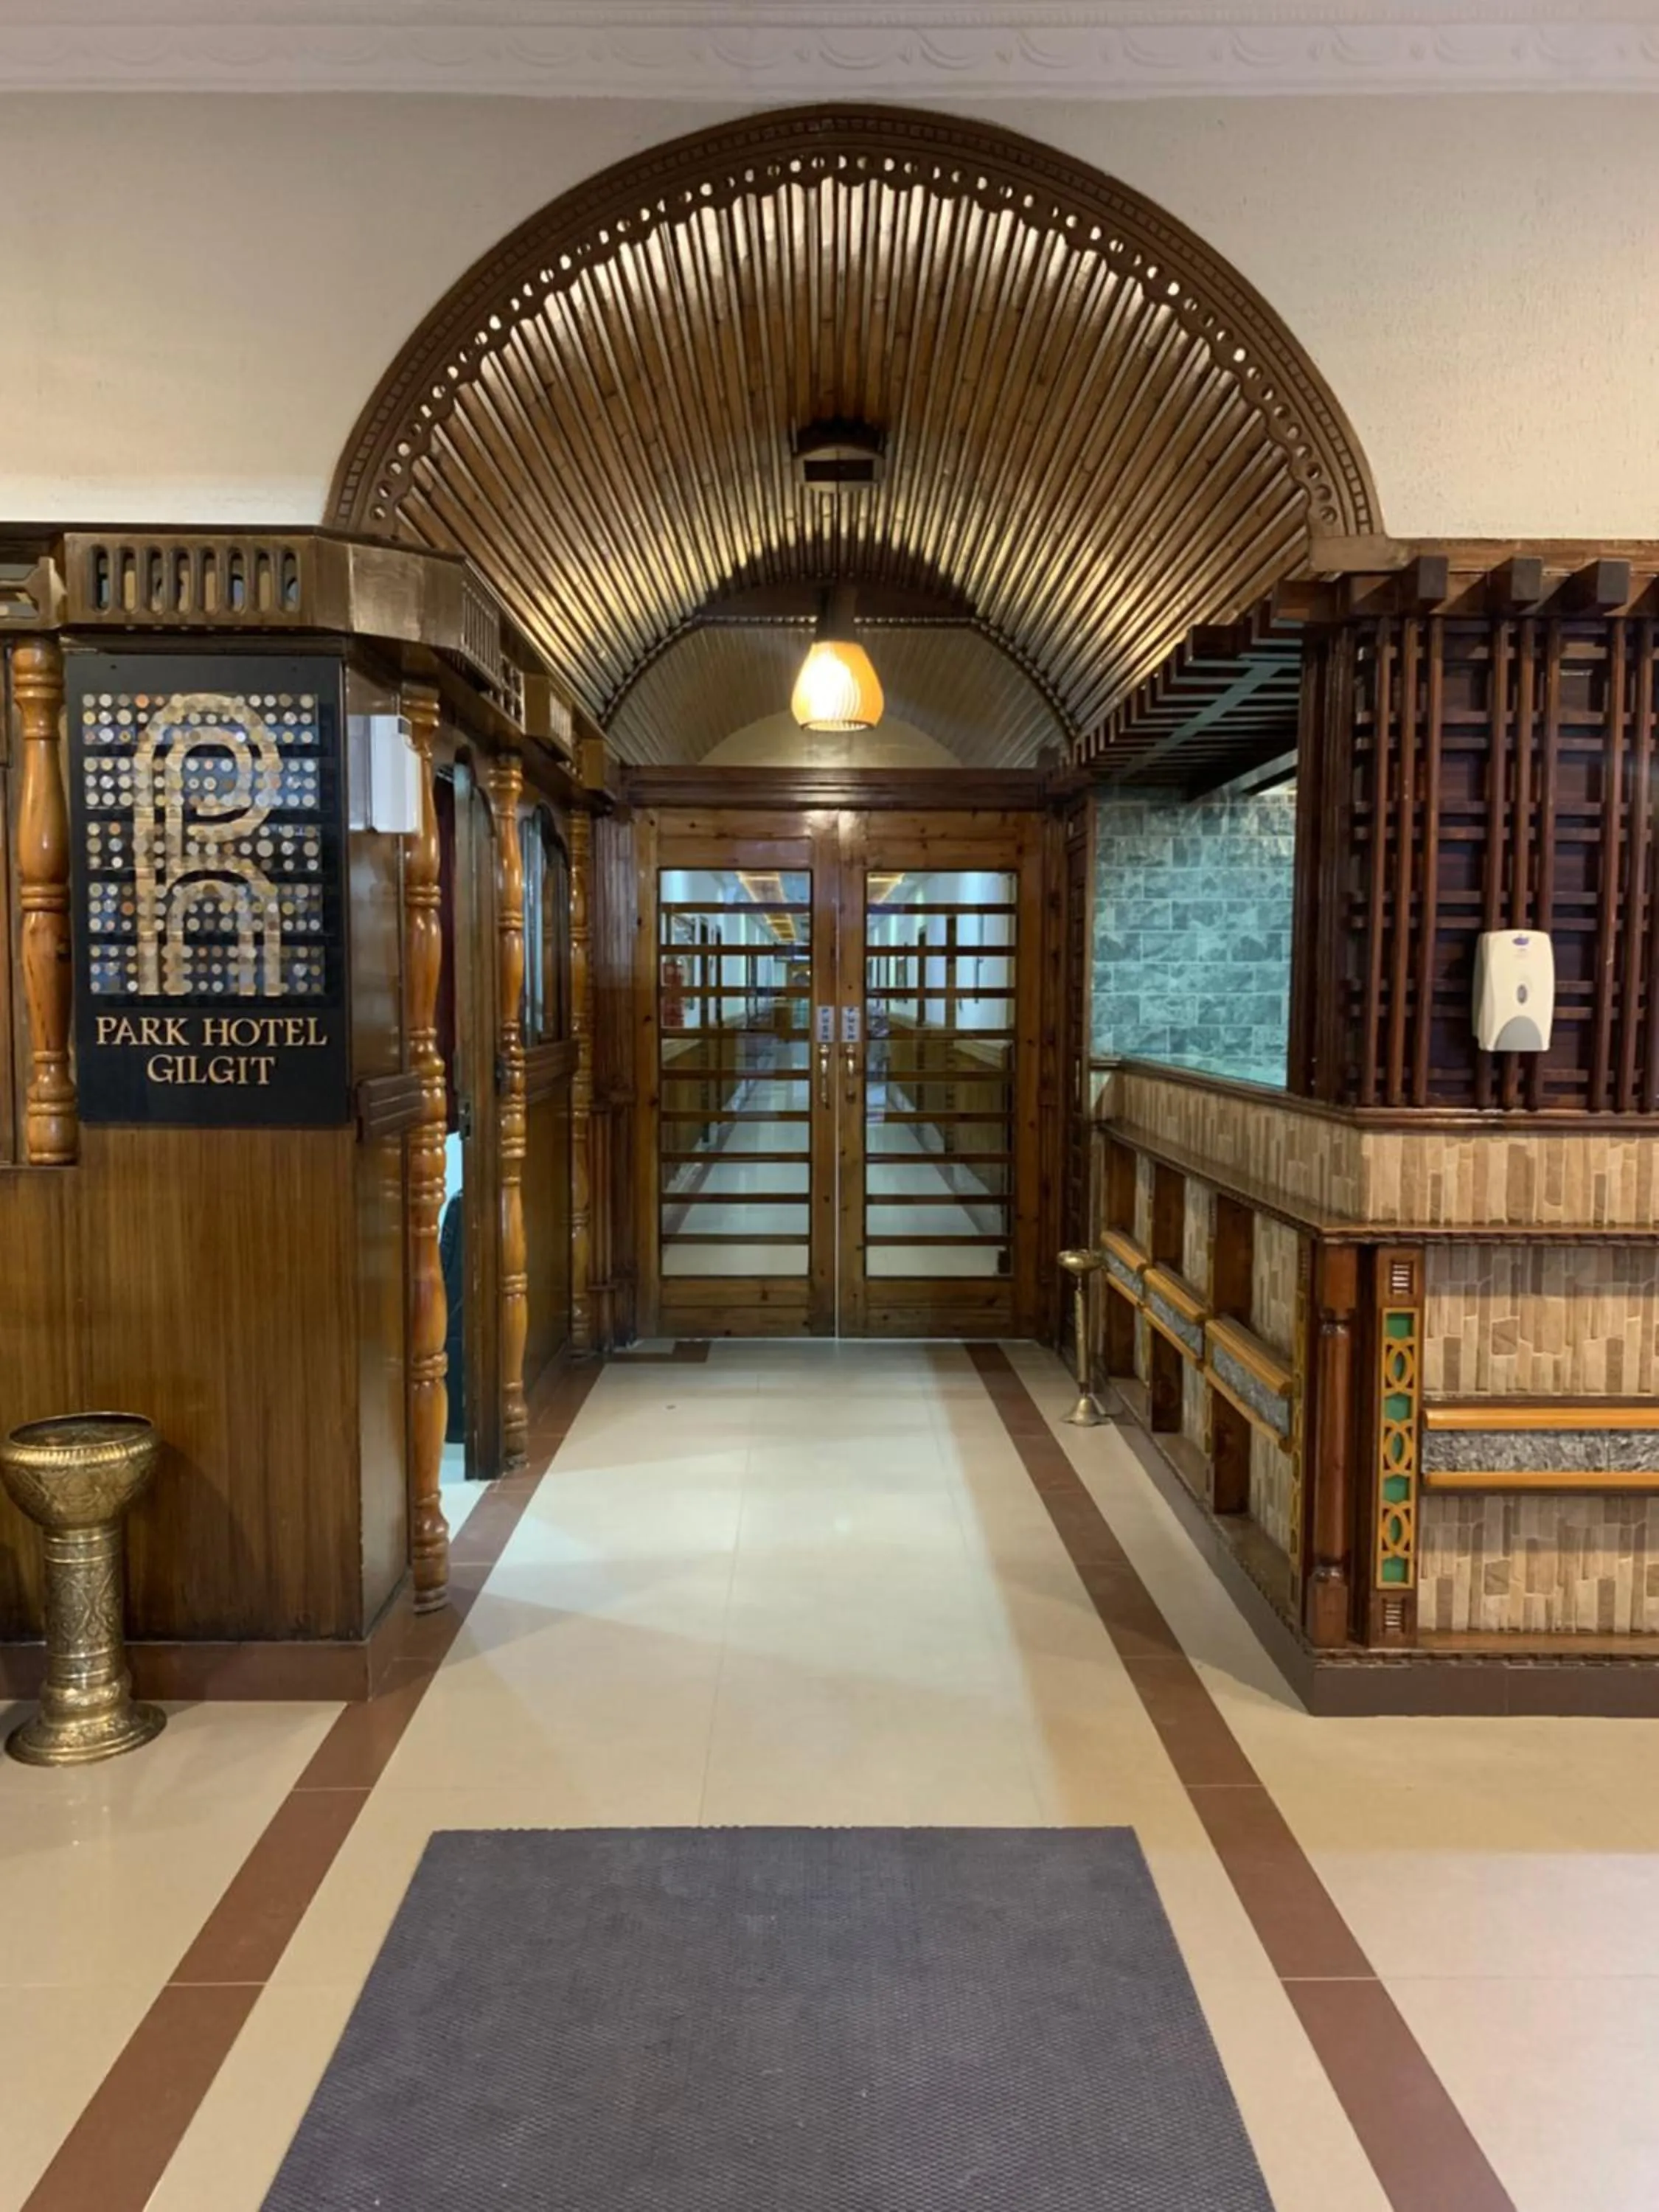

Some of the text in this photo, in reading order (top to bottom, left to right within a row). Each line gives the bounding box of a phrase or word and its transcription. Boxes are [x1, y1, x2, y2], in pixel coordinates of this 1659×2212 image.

[95, 1016, 328, 1047] PARK HOTEL
[147, 1054, 276, 1085] GILGIT
